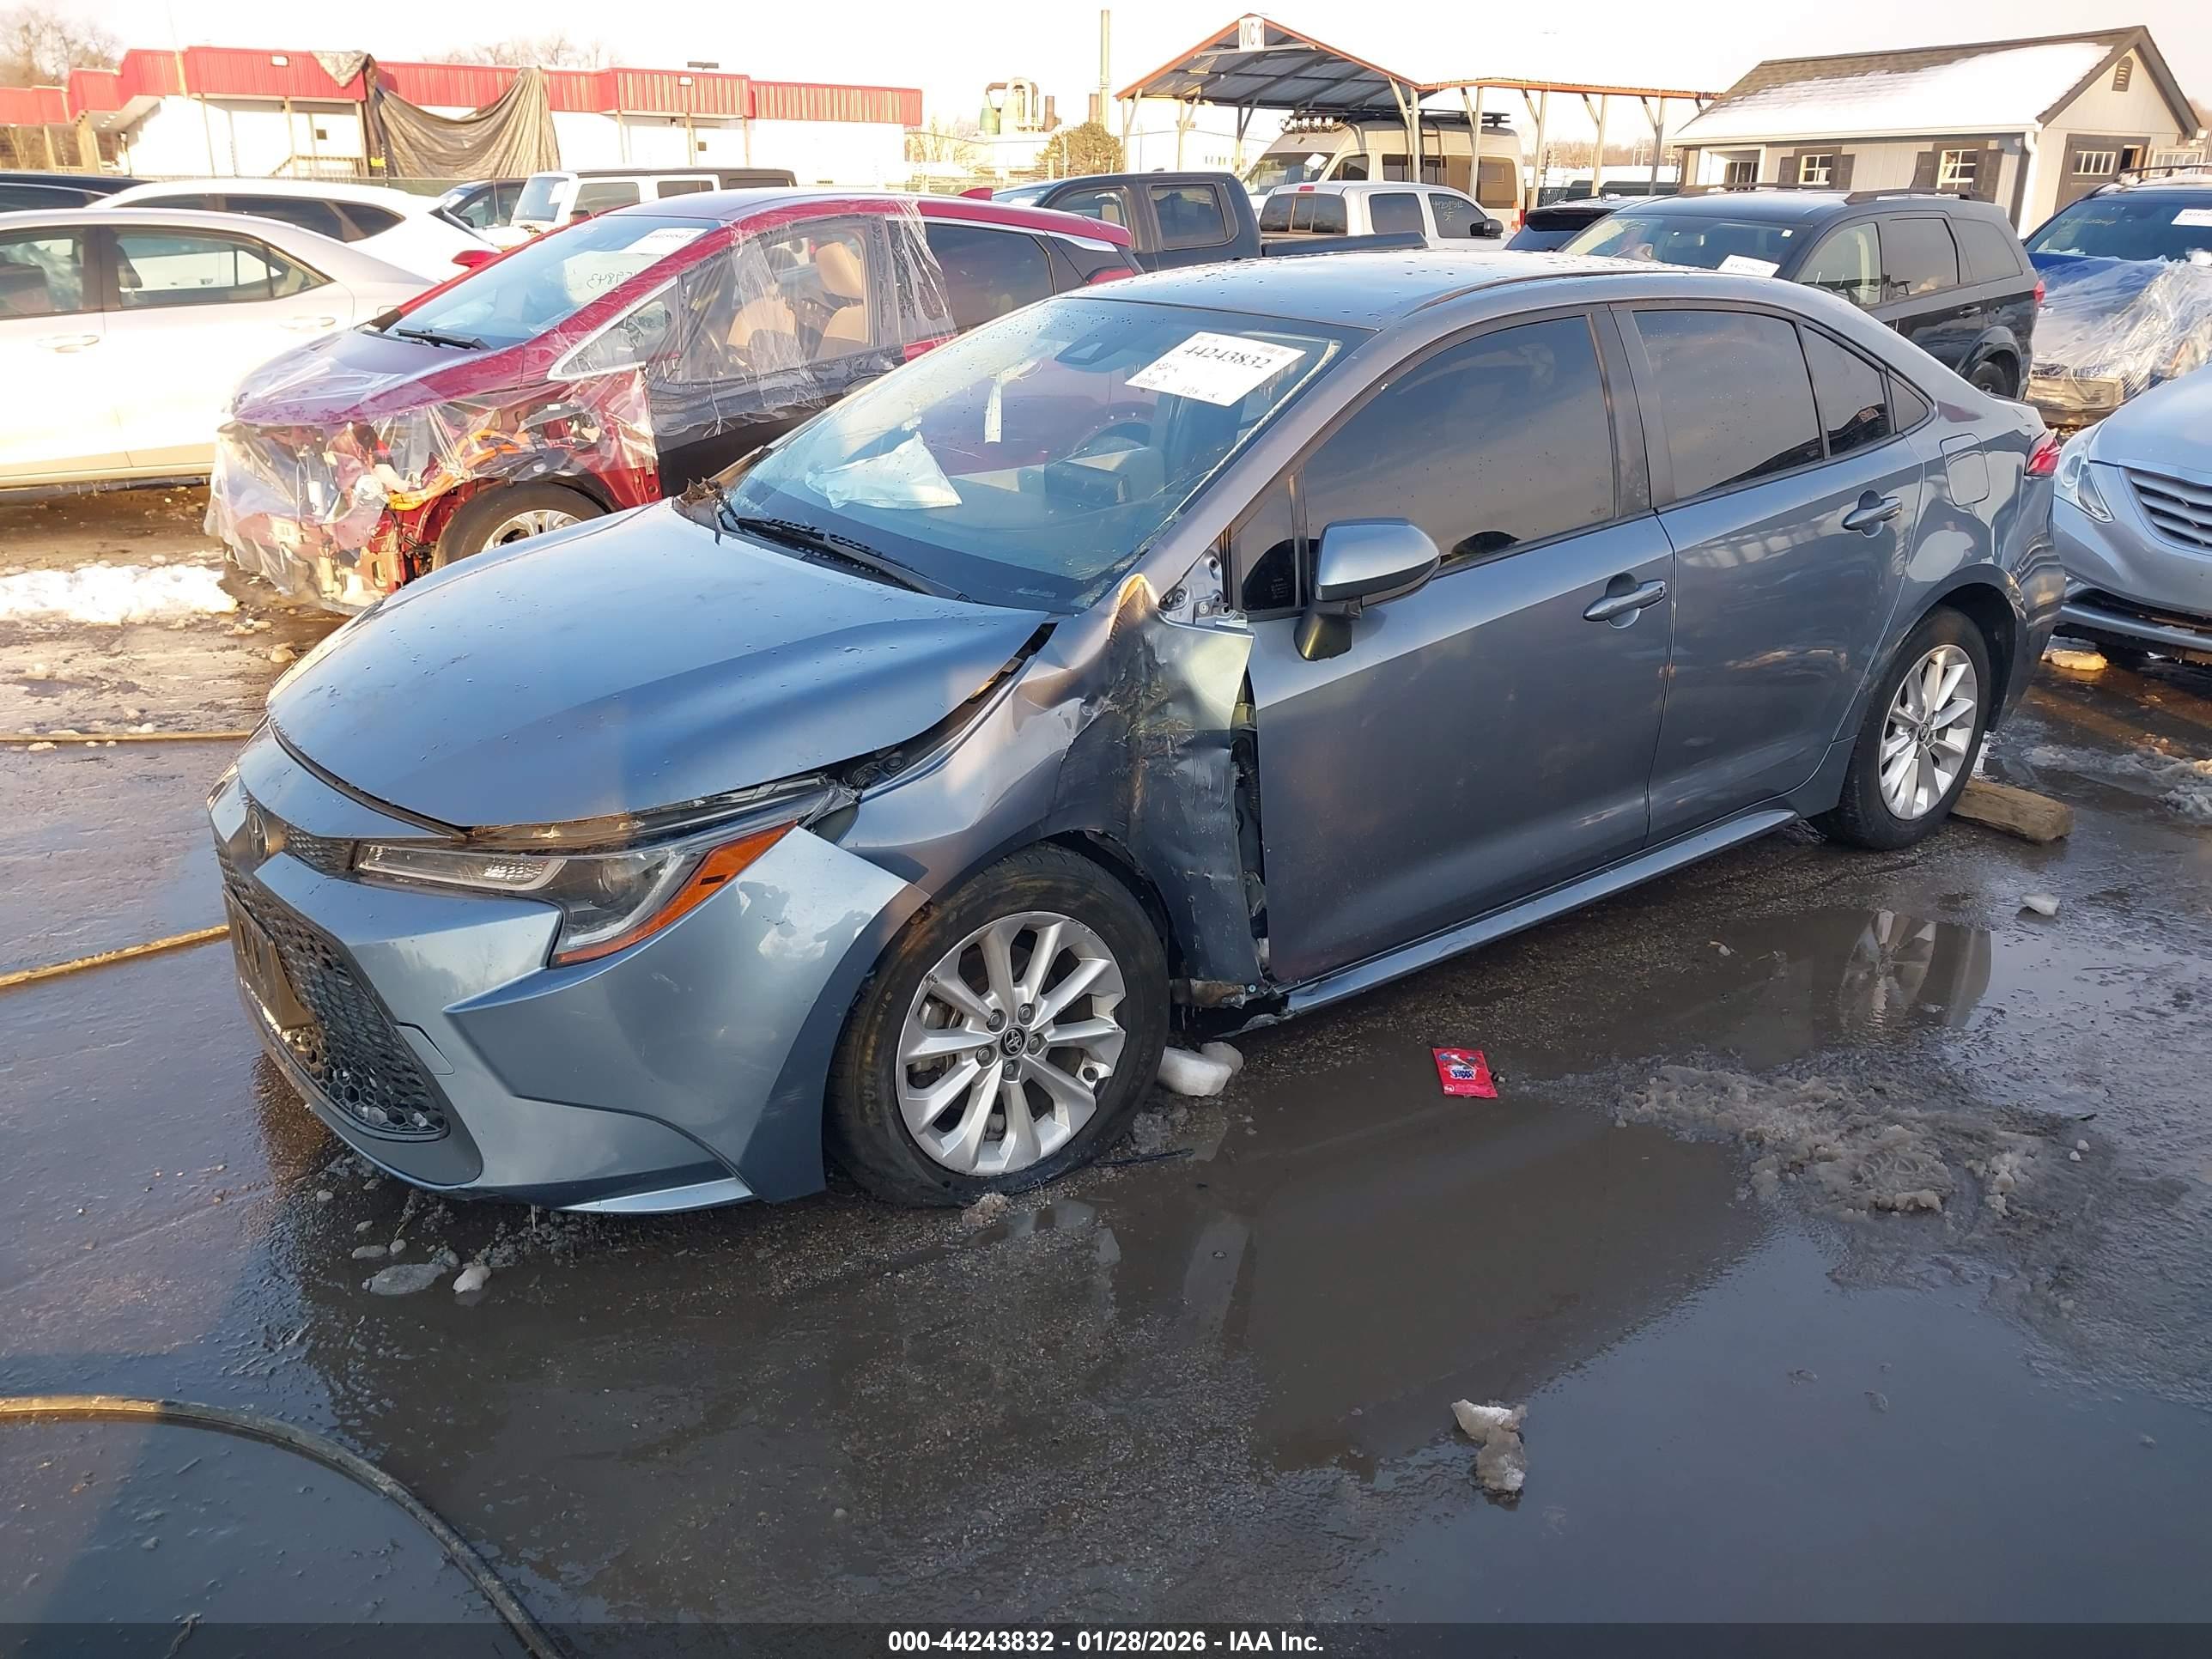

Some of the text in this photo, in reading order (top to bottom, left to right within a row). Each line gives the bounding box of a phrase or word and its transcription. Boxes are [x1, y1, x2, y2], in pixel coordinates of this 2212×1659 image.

[1240, 21, 1263, 46] VIC 1
[1184, 344, 1272, 369] 44243832
